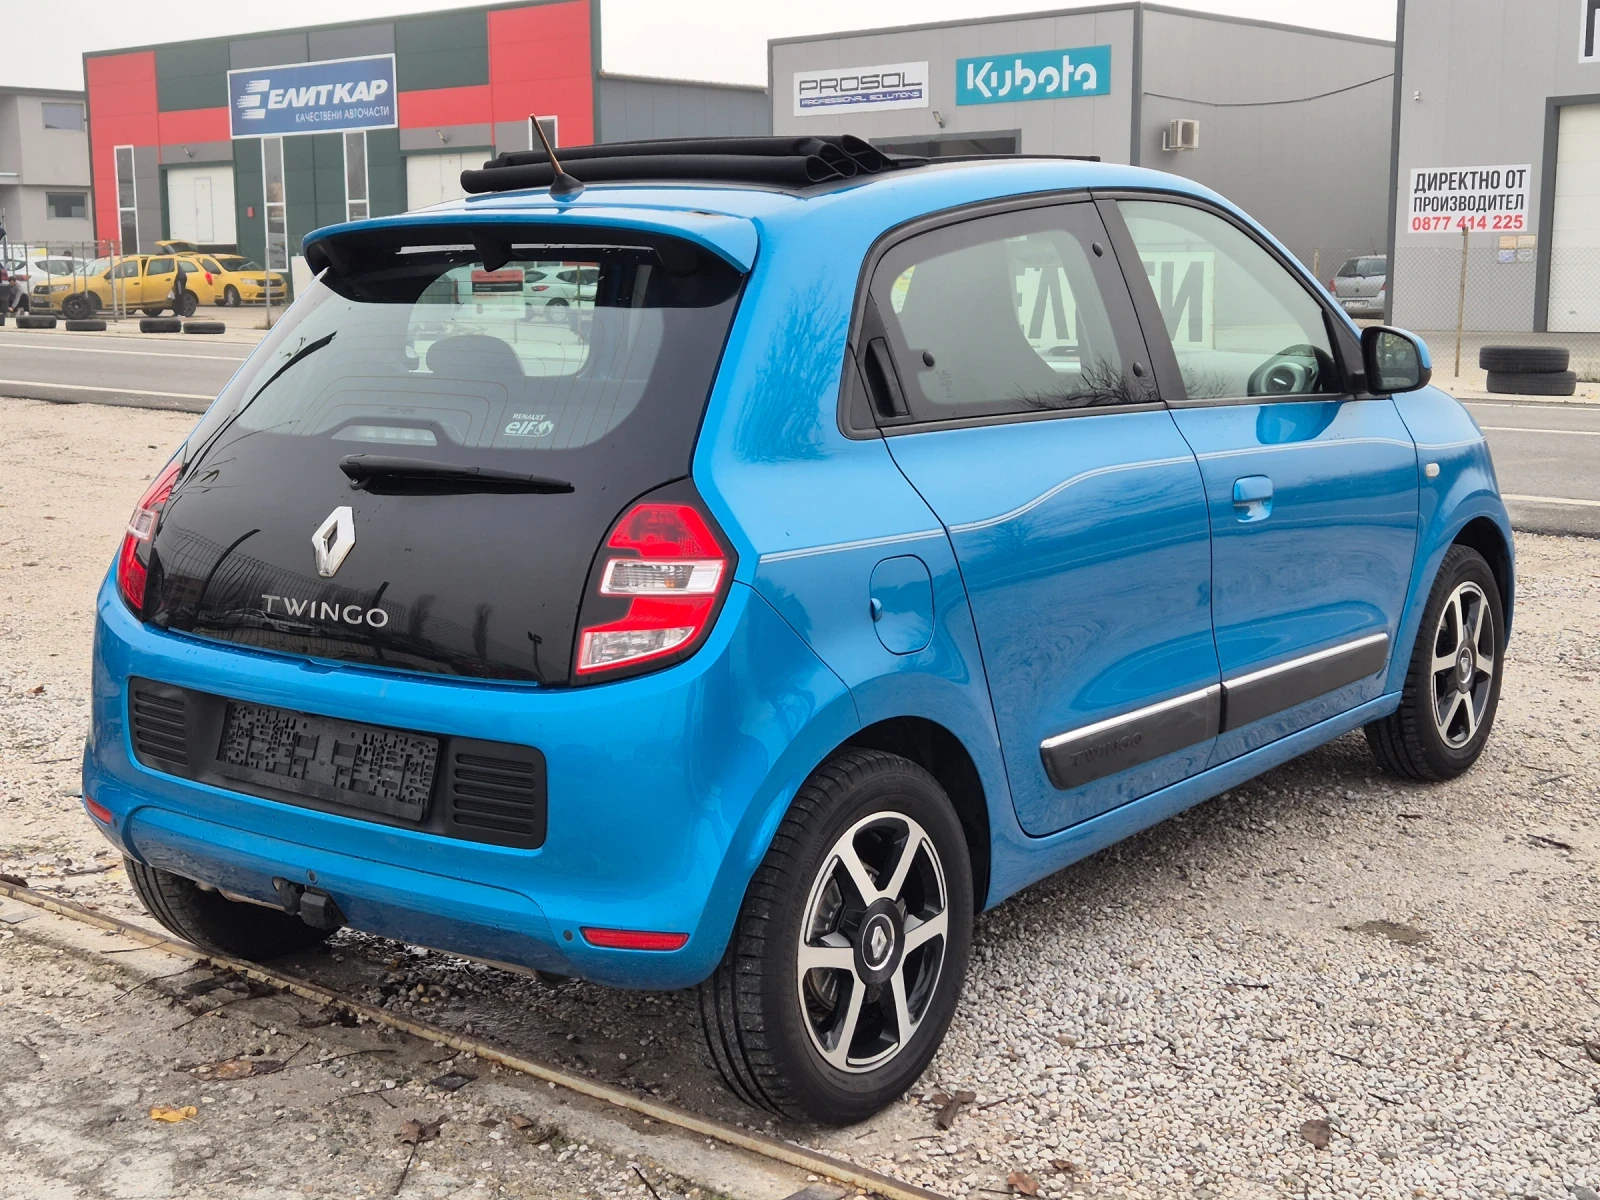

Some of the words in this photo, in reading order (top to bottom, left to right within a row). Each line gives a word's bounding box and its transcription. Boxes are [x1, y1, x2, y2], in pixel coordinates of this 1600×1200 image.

[799, 72, 923, 95] PROSOL
[967, 55, 1097, 97] Kubota
[801, 95, 867, 106] PROFESSIONAL
[869, 91, 920, 101] SOLUTIONS
[295, 110, 342, 123] КАЧЕСТВЕНИ
[344, 106, 390, 119] АВТОЧАСТИ
[1414, 170, 1501, 194] ДИРЕКТНО
[1505, 169, 1527, 189] ОТ
[1413, 194, 1525, 213] ПРОИЗВОДИТЕЛ
[1412, 216, 1452, 231] 0877
[1456, 215, 1487, 230] 414
[1492, 214, 1523, 230] 225
[512, 413, 546, 421] RENAULT
[261, 594, 389, 628] TWINGO
[1069, 731, 1143, 768] TWINGO
